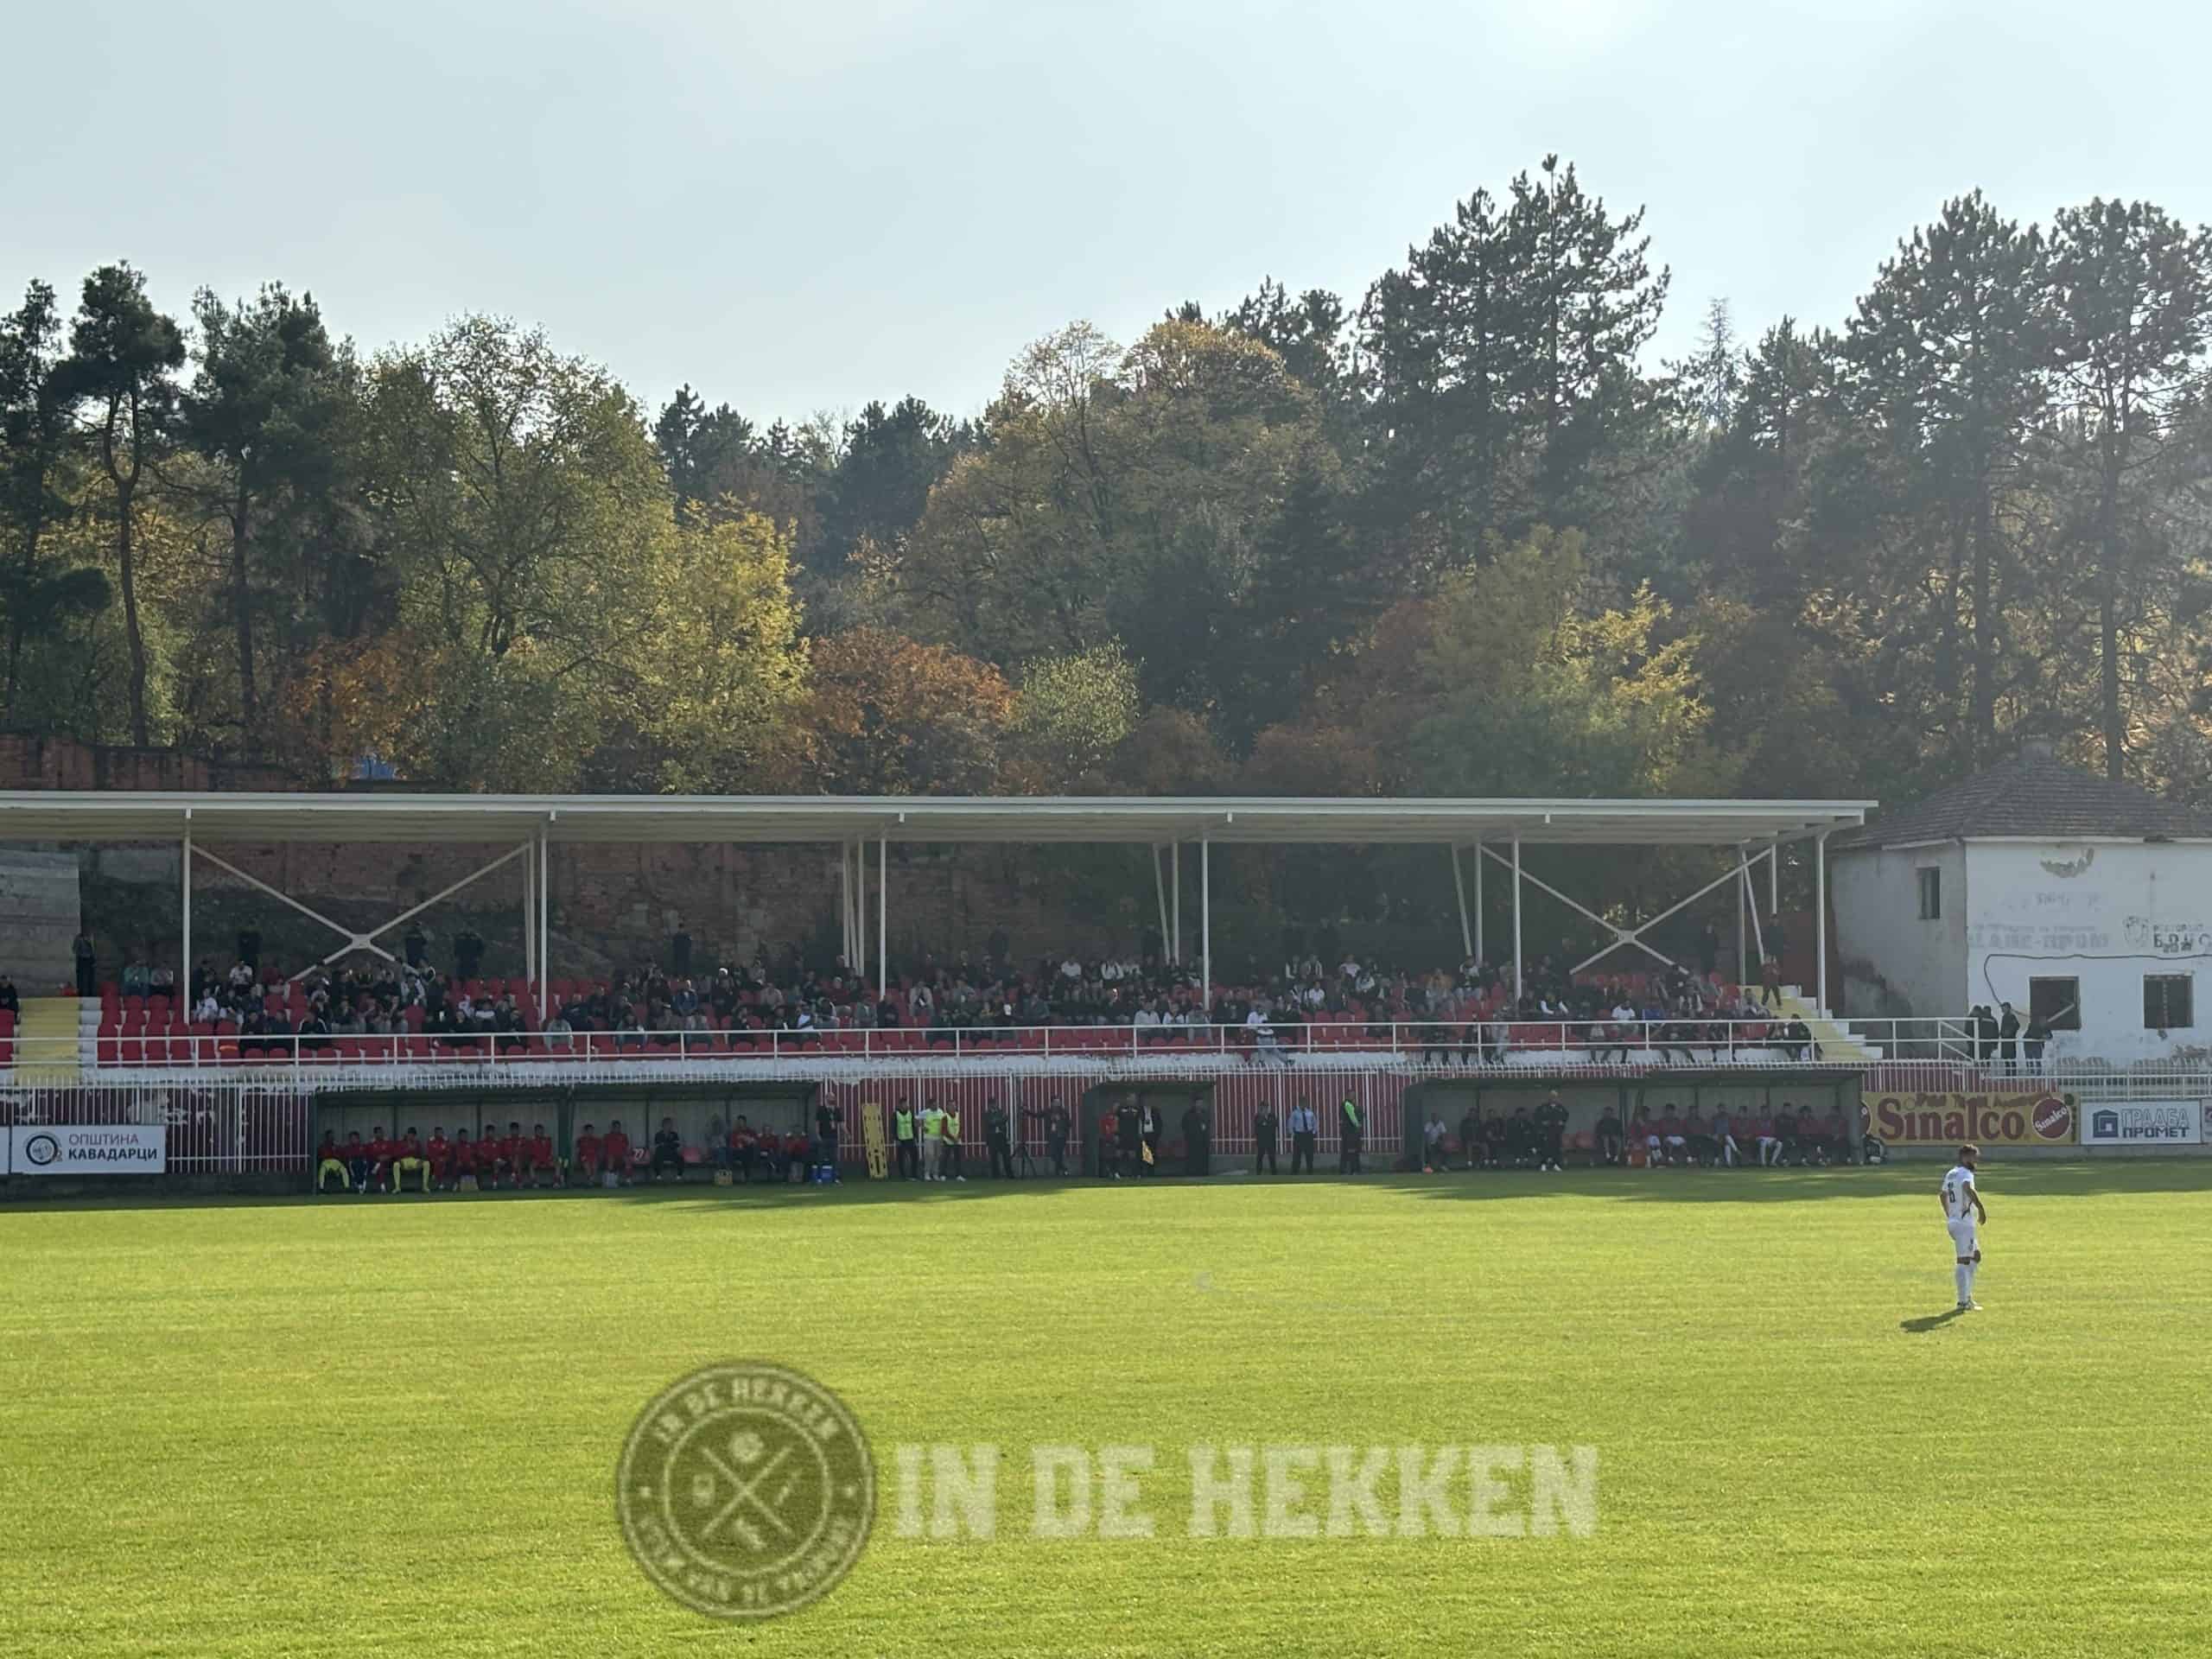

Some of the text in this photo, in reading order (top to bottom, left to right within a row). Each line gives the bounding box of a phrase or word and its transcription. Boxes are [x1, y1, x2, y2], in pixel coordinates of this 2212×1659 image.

[1878, 1097, 2024, 1141] Sinalco
[2122, 1127, 2191, 1138] ПРОМЕТ
[68, 1134, 139, 1146] ОПШТИНА
[68, 1147, 157, 1161] КАВАДАРЦИ
